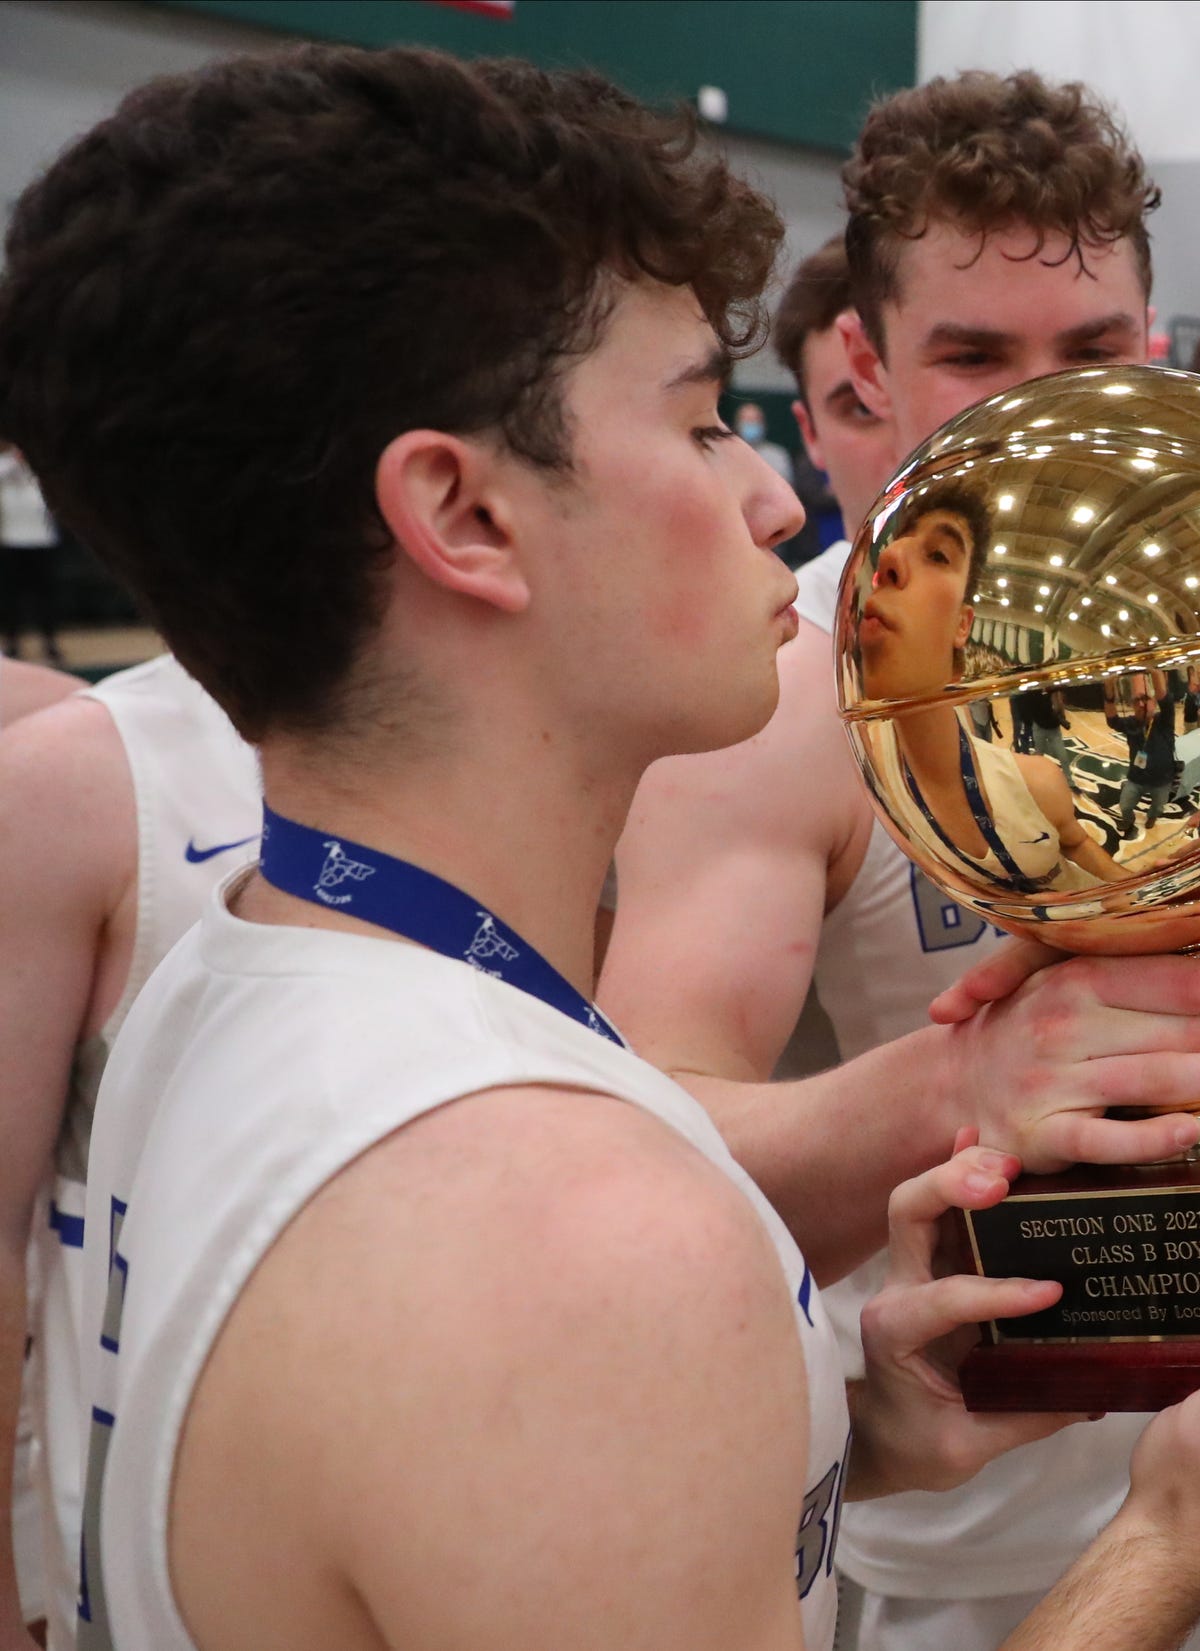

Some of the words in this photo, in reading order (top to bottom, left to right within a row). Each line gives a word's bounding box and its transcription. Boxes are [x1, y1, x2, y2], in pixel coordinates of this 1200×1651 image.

[1020, 1216, 1105, 1239] SECTION
[1113, 1213, 1157, 1234] ONE
[1071, 1244, 1135, 1265] CLASS
[1141, 1243, 1157, 1262] B
[1062, 1307, 1142, 1325] Sponsored
[1149, 1304, 1168, 1322] By
